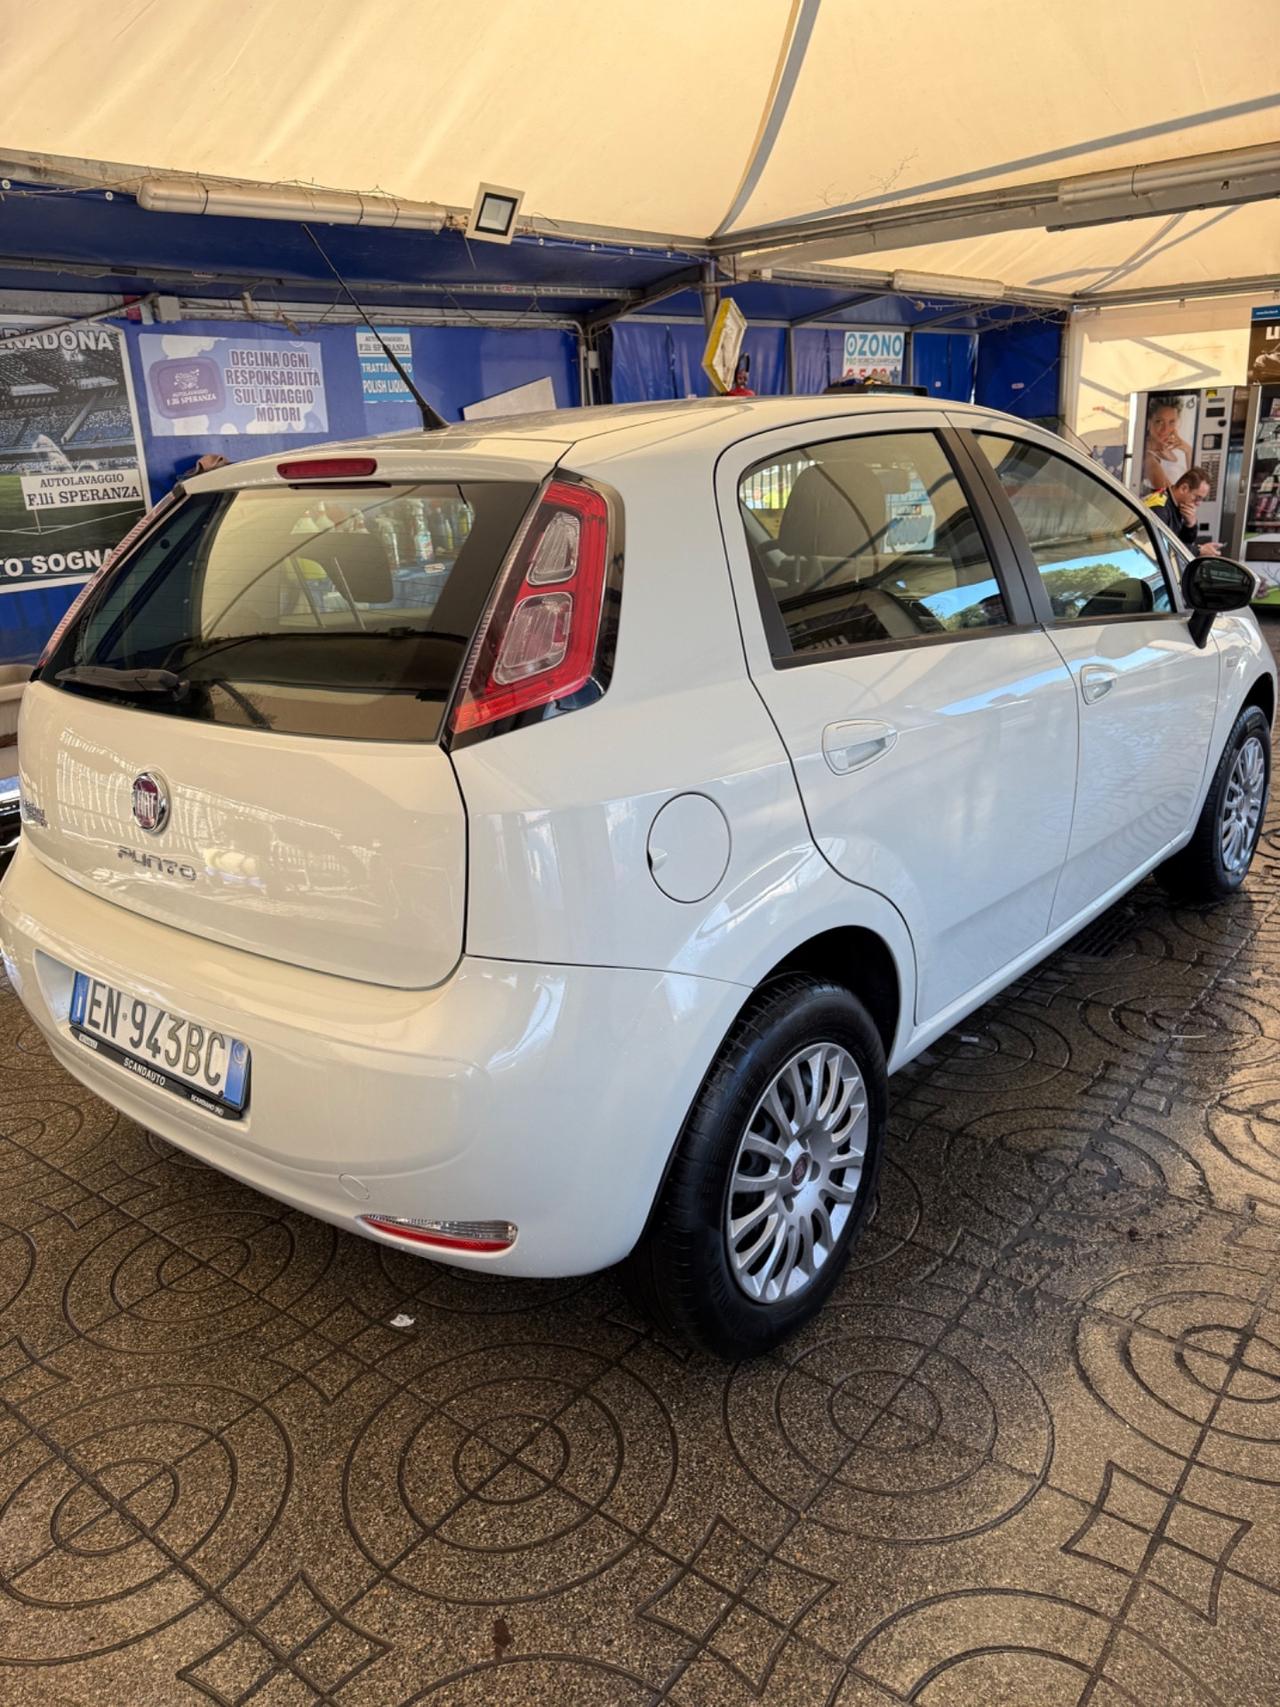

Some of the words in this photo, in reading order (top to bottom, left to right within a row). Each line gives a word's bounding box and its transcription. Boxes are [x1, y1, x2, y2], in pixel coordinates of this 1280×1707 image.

[0, 326, 115, 351] RADONA
[846, 333, 902, 357] OZONO
[230, 350, 281, 368] DECLINA
[282, 352, 310, 368] OGNI
[224, 366, 321, 387] RESPONSABILITÀ
[234, 387, 258, 404] SUL
[260, 387, 315, 405] LAVAGGIO
[256, 406, 302, 422] MOTORI
[40, 473, 125, 489] AUTOLAVAGGIO
[26, 492, 56, 507] F.lli
[58, 485, 141, 505] SPERANZA
[0, 558, 24, 578] O
[117, 845, 197, 881] PUNTO
[88, 979, 122, 1039] EN
[128, 999, 226, 1087] 943BC
[123, 1056, 166, 1087] SCANDAUTO
